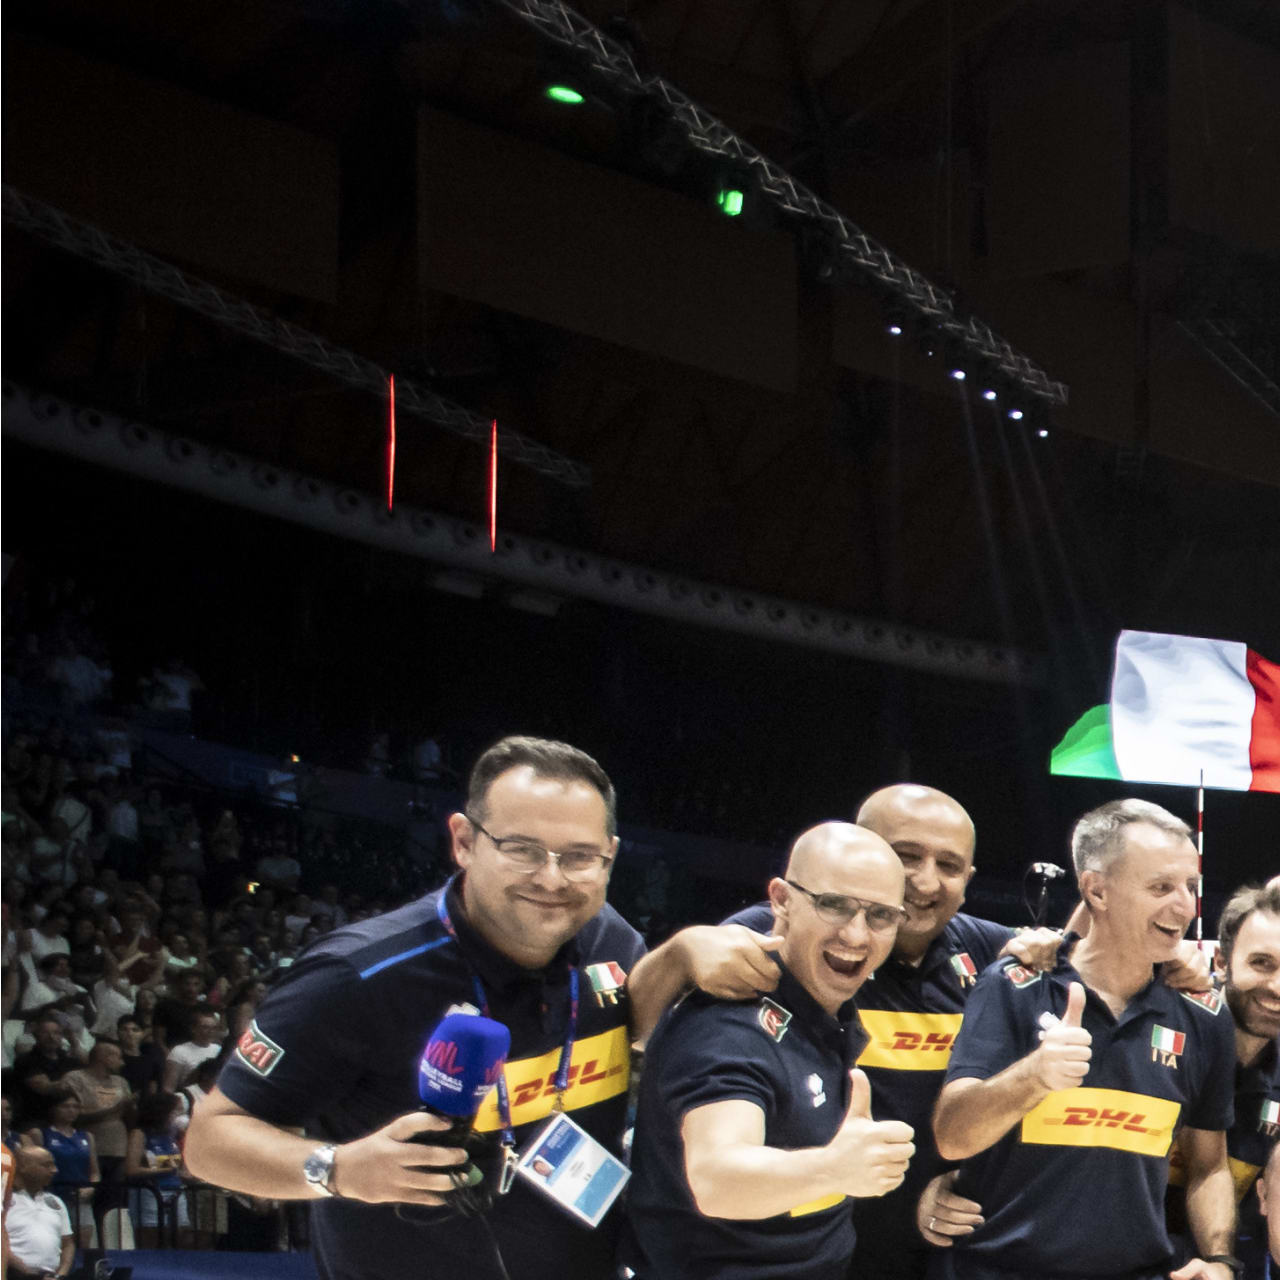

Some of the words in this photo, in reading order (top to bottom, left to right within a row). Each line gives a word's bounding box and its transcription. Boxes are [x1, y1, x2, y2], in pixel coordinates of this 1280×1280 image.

[892, 1031, 953, 1052] DH
[1152, 1053, 1178, 1070] ITA
[1063, 1107, 1148, 1133] DHL
